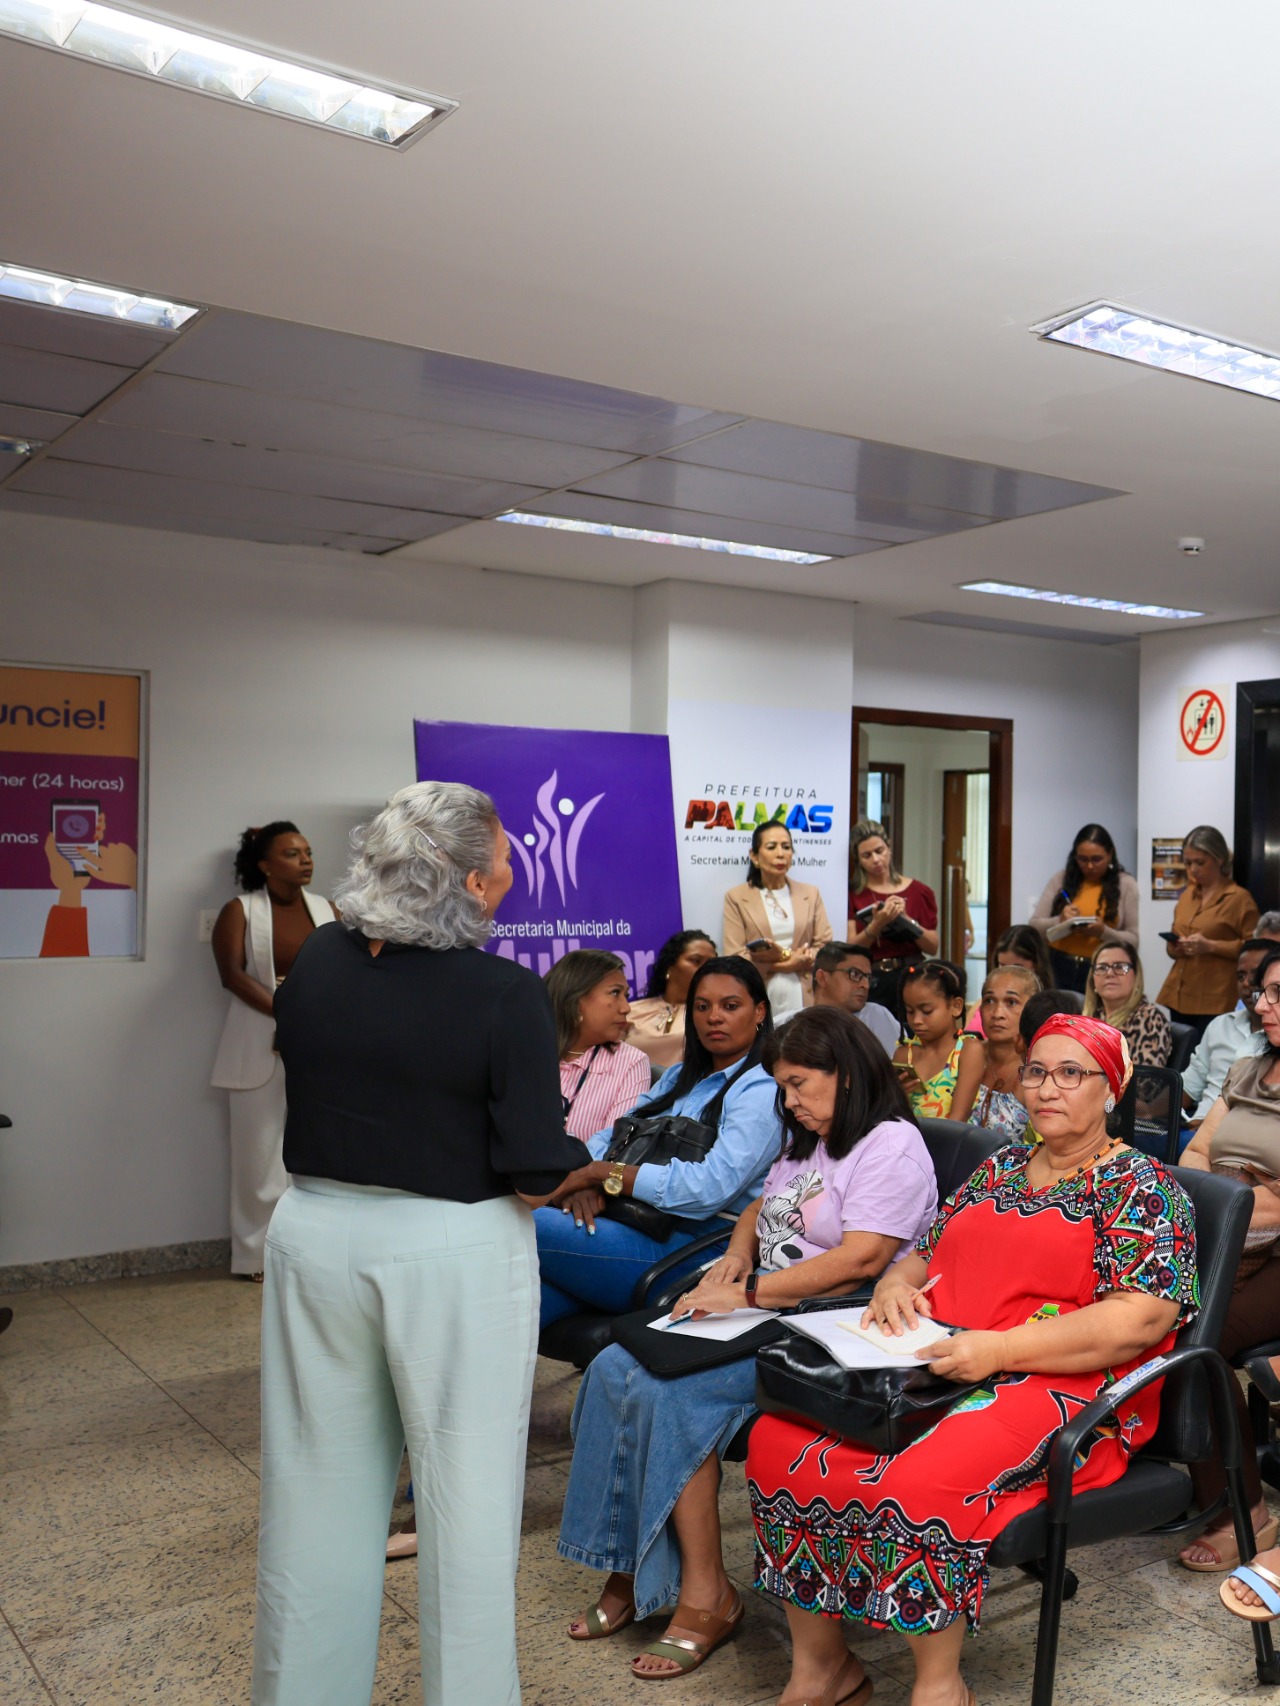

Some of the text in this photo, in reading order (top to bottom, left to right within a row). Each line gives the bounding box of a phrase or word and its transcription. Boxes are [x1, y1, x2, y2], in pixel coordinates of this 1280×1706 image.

[32, 773, 64, 790] (24
[70, 774, 125, 793] horas)
[704, 783, 818, 800] PREFEITURA
[684, 799, 834, 834] PALMAS
[692, 835, 723, 843] CAPITAL
[792, 838, 832, 846] NTINENSES
[690, 854, 740, 866] Secretaria
[797, 856, 828, 868] Mulher
[490, 919, 632, 939] Secretaria Municipal da
